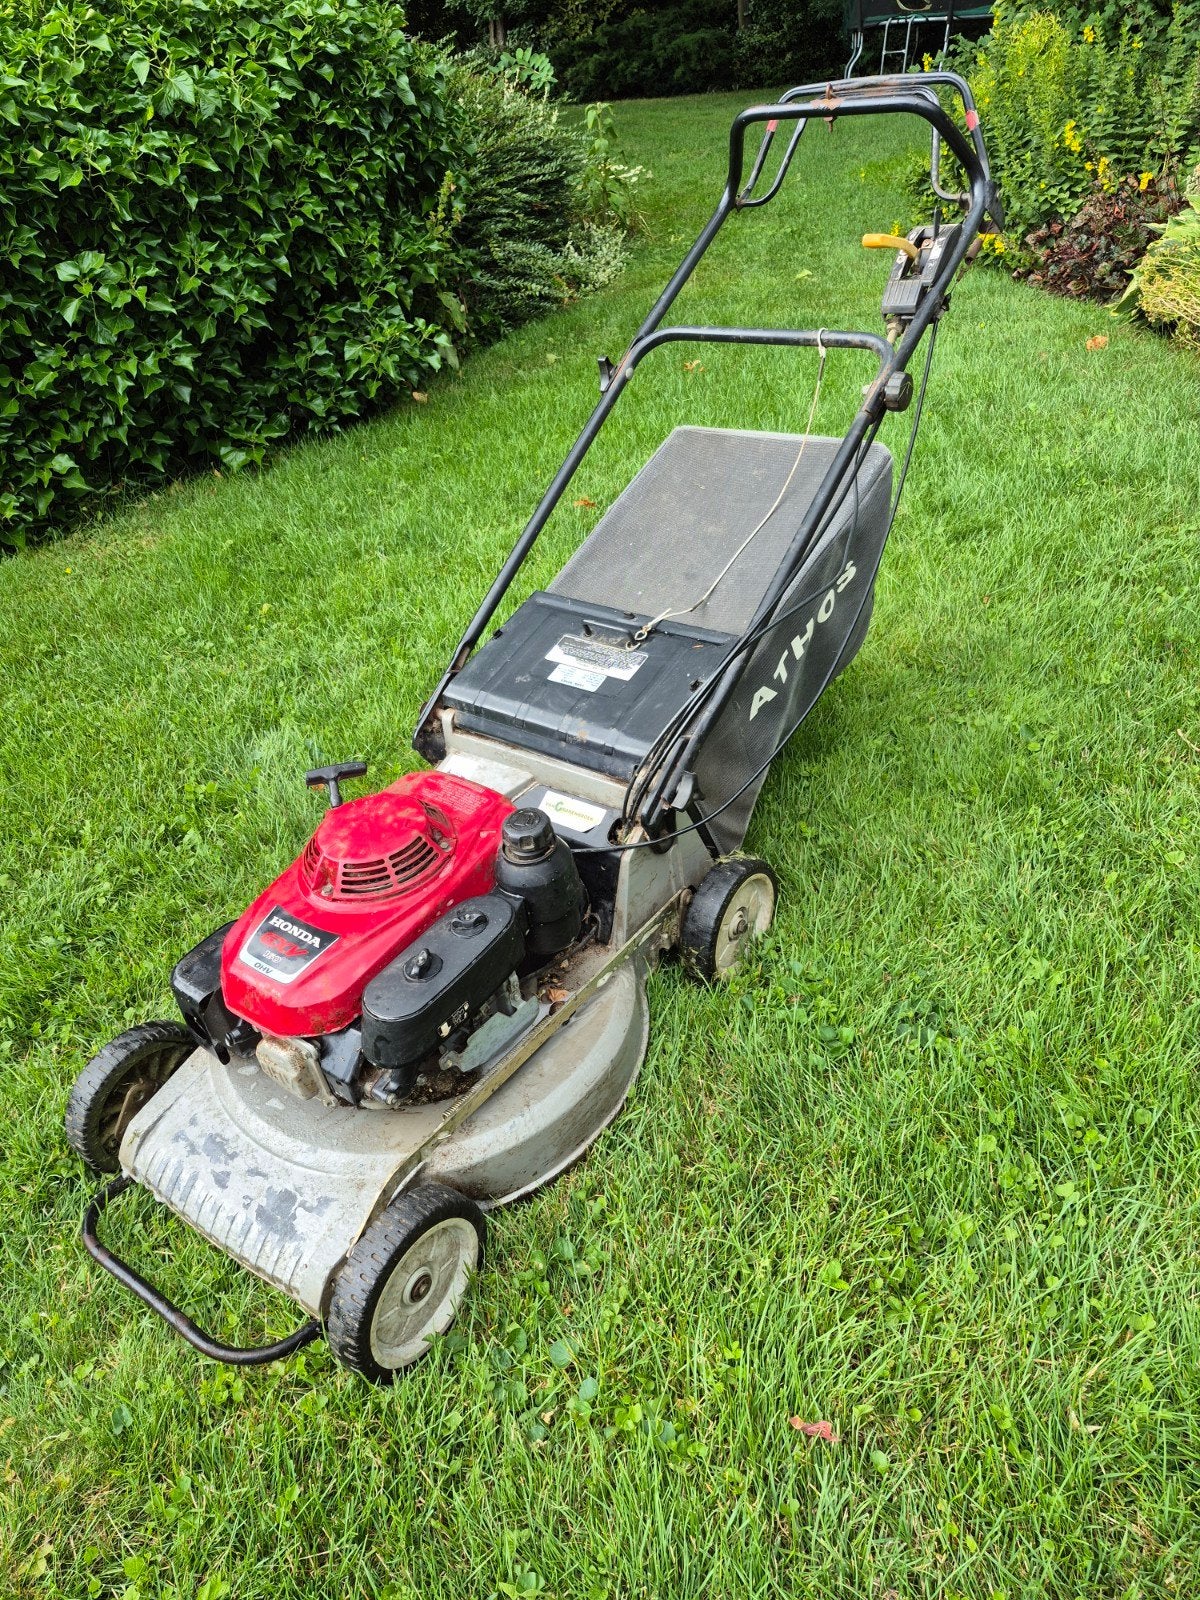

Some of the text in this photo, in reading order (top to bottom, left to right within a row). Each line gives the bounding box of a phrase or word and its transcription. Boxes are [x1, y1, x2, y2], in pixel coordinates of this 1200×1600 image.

[750, 561, 856, 721] ATHOS
[268, 916, 321, 948] HONDA
[254, 962, 273, 974] OHV
